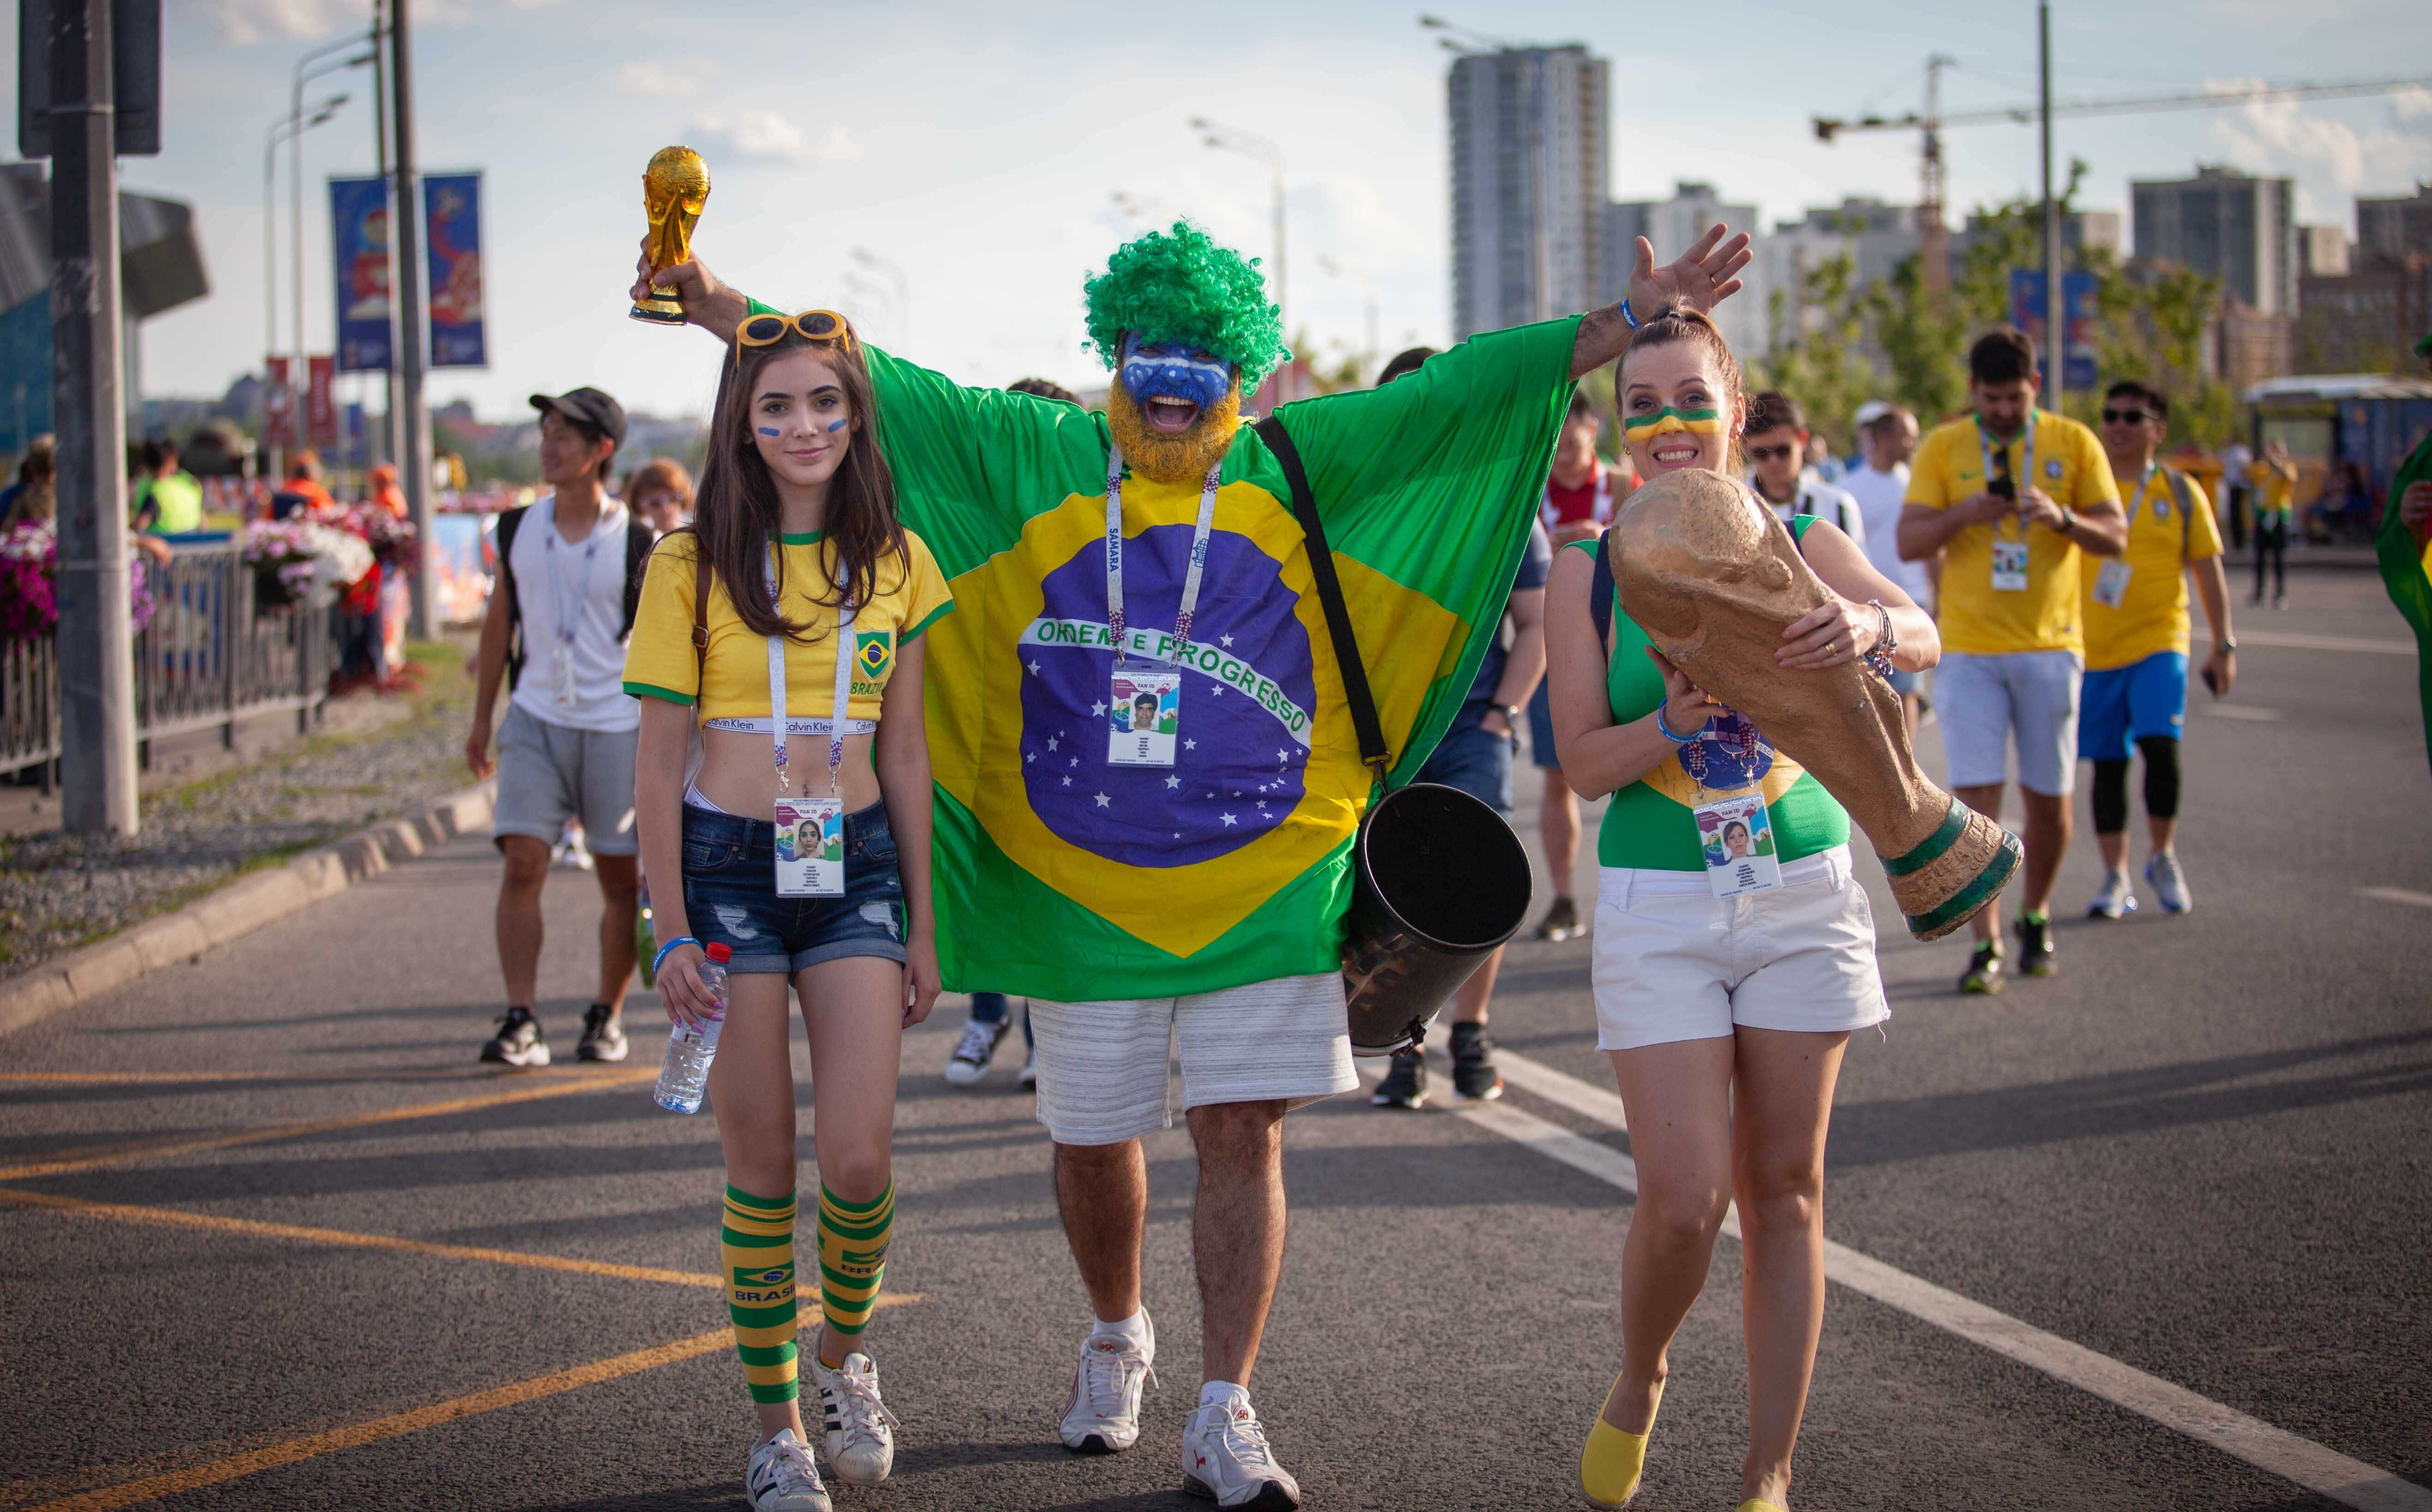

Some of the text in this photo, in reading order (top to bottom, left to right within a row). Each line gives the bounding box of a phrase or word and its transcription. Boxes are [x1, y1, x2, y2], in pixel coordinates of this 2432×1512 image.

[1109, 528, 1119, 572] SAMARA
[850, 682, 884, 695] BRAZIL
[1133, 633, 1148, 650] E
[1156, 635, 1306, 732] PROGRESSO
[731, 719, 754, 729] Klein
[856, 721, 872, 731] Calvin
